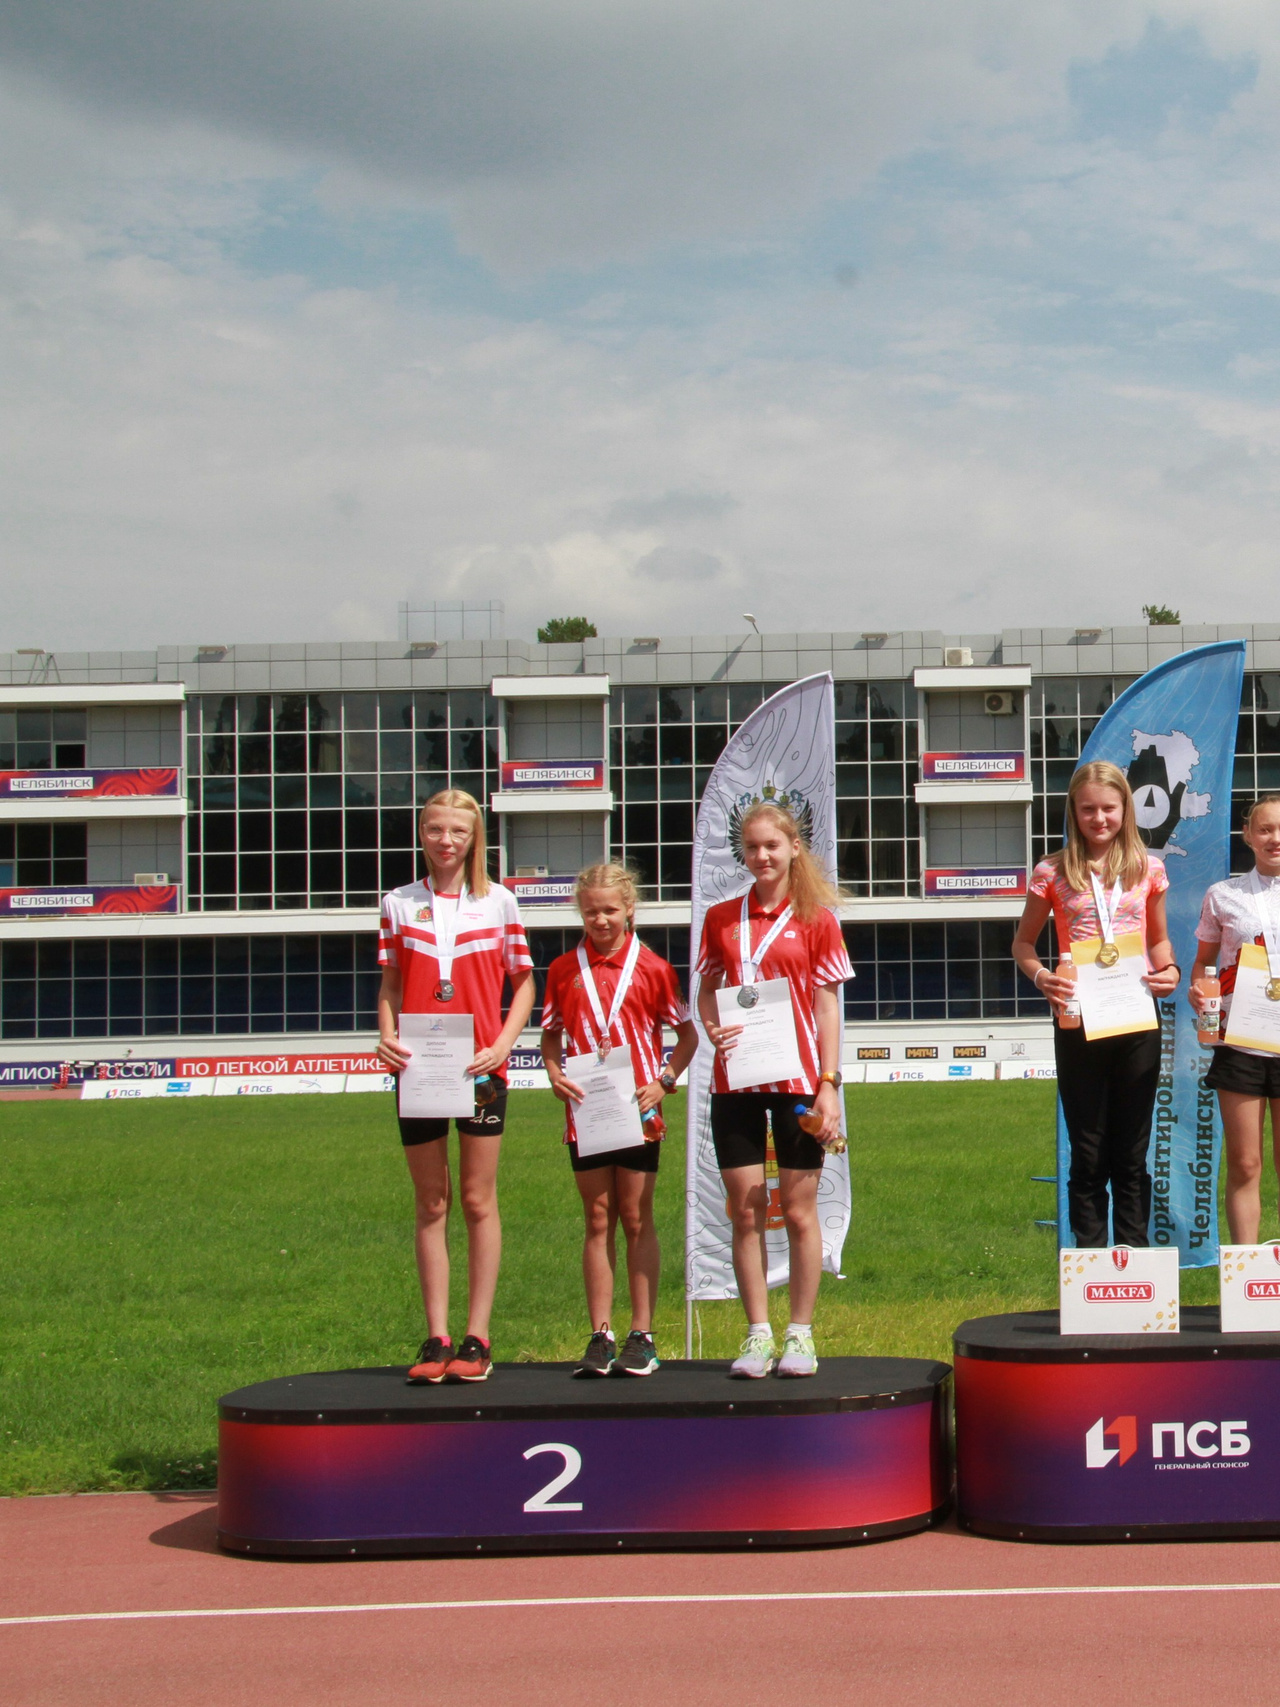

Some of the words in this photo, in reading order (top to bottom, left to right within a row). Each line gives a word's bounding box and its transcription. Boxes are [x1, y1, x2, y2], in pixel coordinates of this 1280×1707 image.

[936, 761, 1014, 771] ЧЕЛЯБИНСК
[515, 769, 592, 780] ЧЕЛЯБИНСК
[12, 778, 92, 789] ЧЕЛЯБИНСК
[938, 877, 1015, 888] ЧЕЛЯБИНСК
[12, 895, 92, 906] ЧЕЛЯБИНСК
[182, 1062, 210, 1077] ПО
[215, 1057, 289, 1075] ЛЕГКОЙ
[294, 1058, 387, 1073] АТЛЕТИКЕ
[903, 1072, 924, 1080] ПСБ
[513, 1079, 534, 1087] ПСБ
[119, 1089, 141, 1097] ПСБ
[251, 1085, 273, 1093] ПСБ
[1153, 1001, 1179, 1246] ориентирования
[1090, 1286, 1149, 1299] MAKFA
[1151, 1420, 1252, 1458] ПСБ
[1154, 1462, 1211, 1470] ГЕНЕРАЛЬНЫЙ
[1212, 1461, 1250, 1469] СПОНСОР
[522, 1441, 584, 1512] 2
